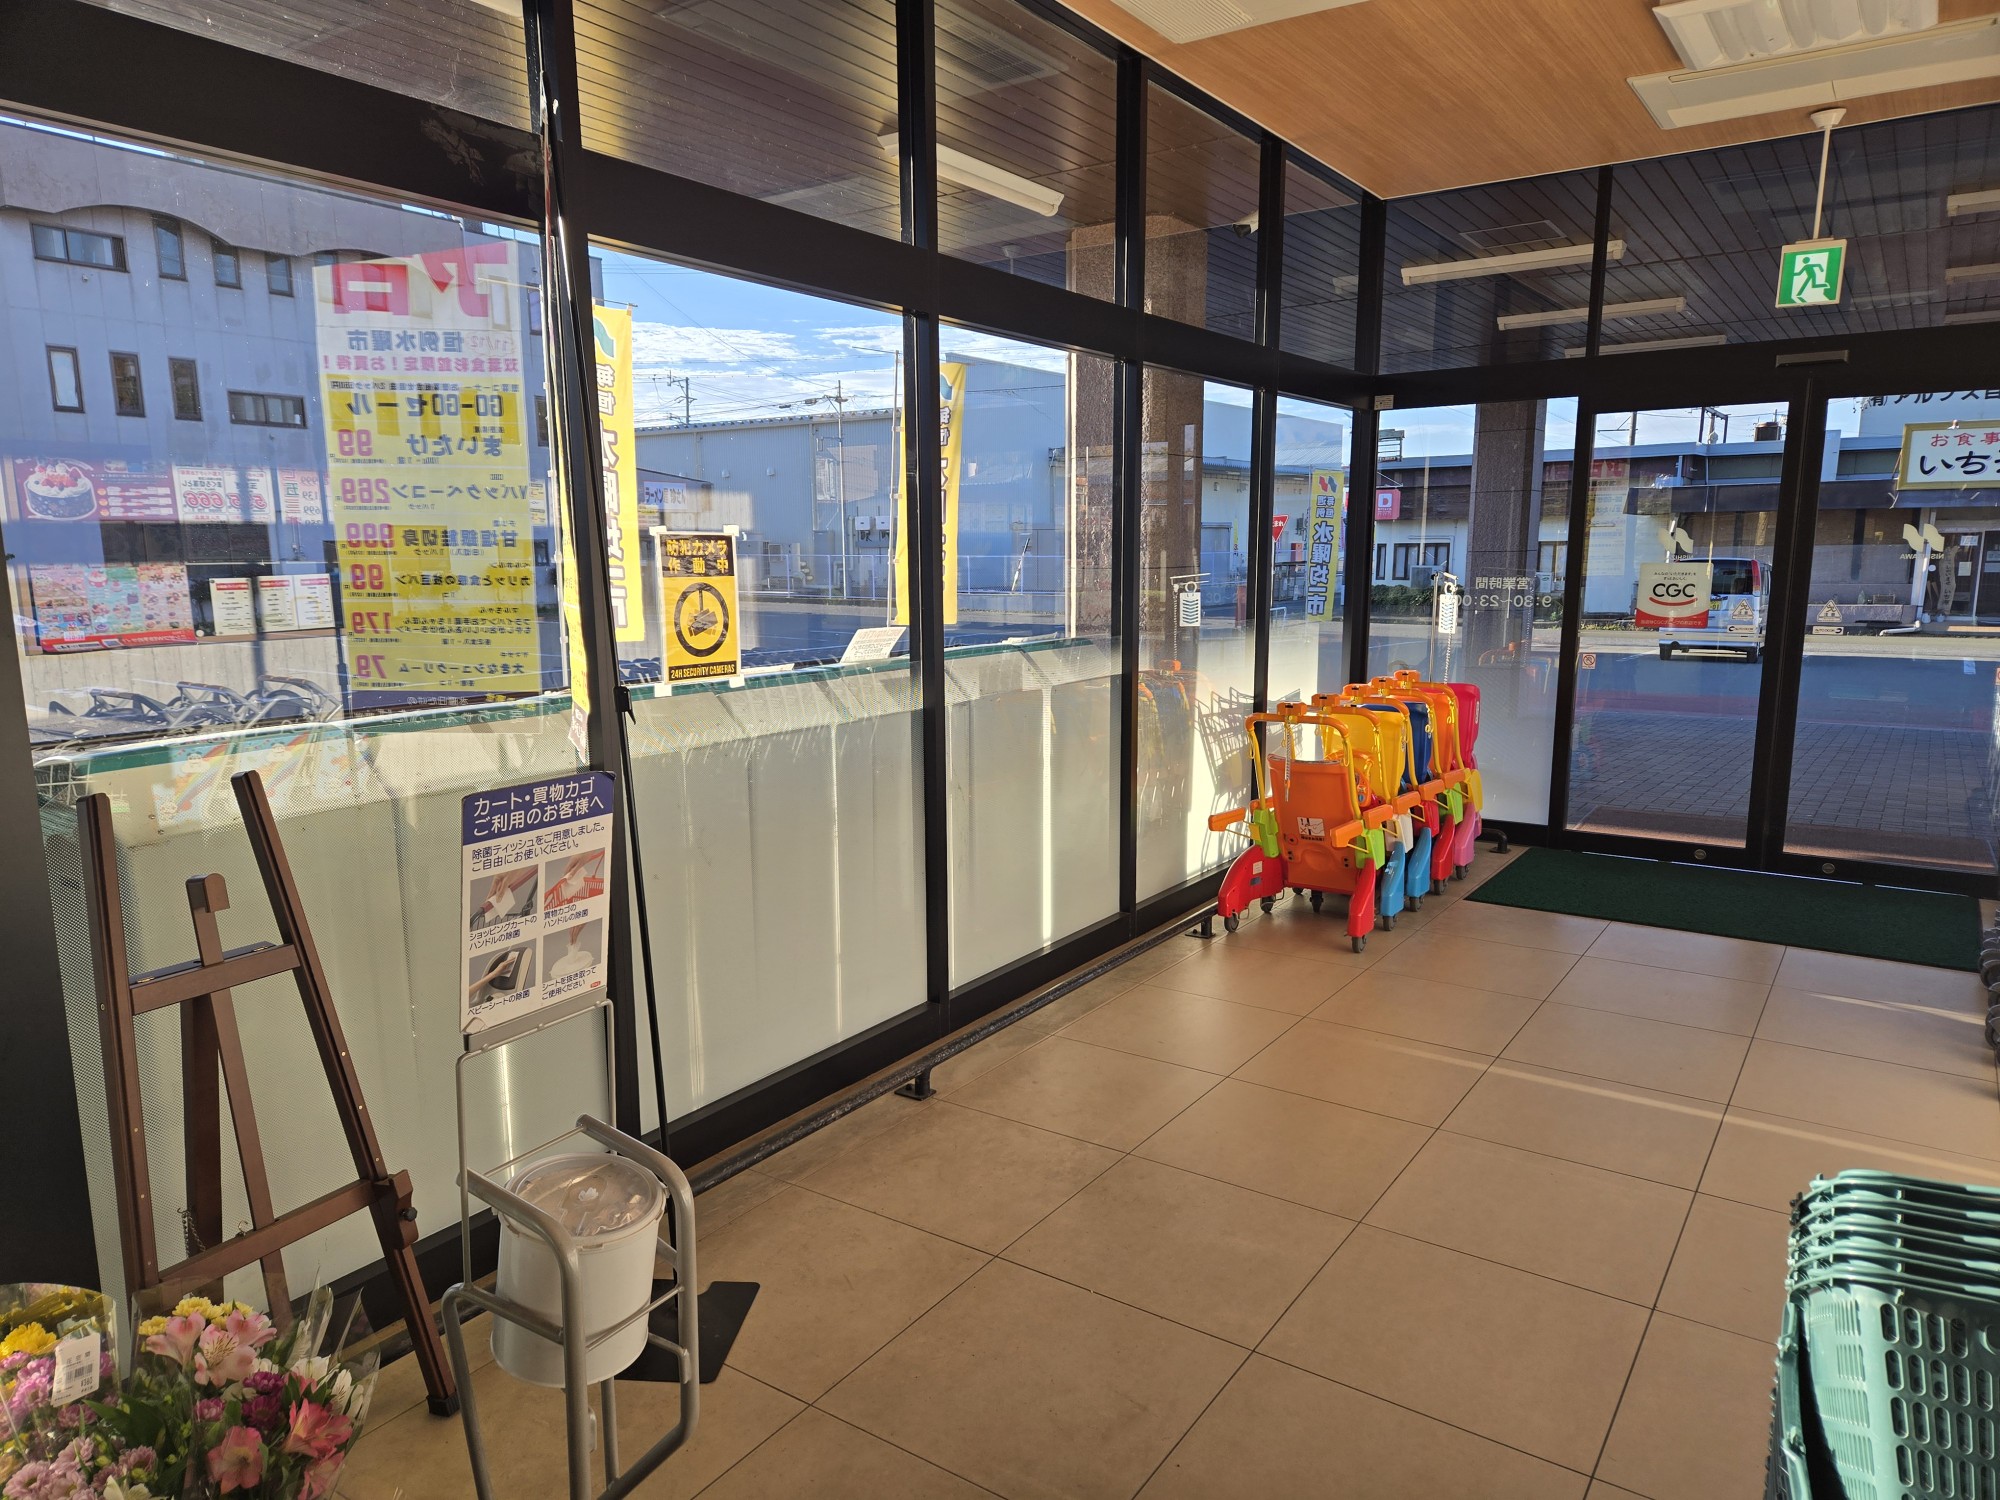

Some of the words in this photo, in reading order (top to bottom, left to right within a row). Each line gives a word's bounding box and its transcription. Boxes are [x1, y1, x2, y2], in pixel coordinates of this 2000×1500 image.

[666, 540, 728, 556] 防犯カメラ
[668, 558, 729, 575] 作動中
[1652, 583, 1696, 598] CGC
[671, 668, 683, 679] 24H
[683, 665, 709, 678] SECURITY
[709, 664, 735, 676] CAMERAS
[474, 776, 595, 817] カート・買物カゴ
[474, 795, 604, 836] ご利用のお客様へ
[471, 822, 605, 861] 除菌ティッシュをご用意しました。
[471, 840, 580, 872] ご自由にお使いください。
[543, 903, 577, 920] 買物カゴの
[543, 908, 589, 928] ハンドルの除菌
[469, 914, 538, 941] ショッピングカートの
[468, 929, 521, 950] ハンドルの除菌
[467, 989, 531, 1016] ベビーシートの除菌
